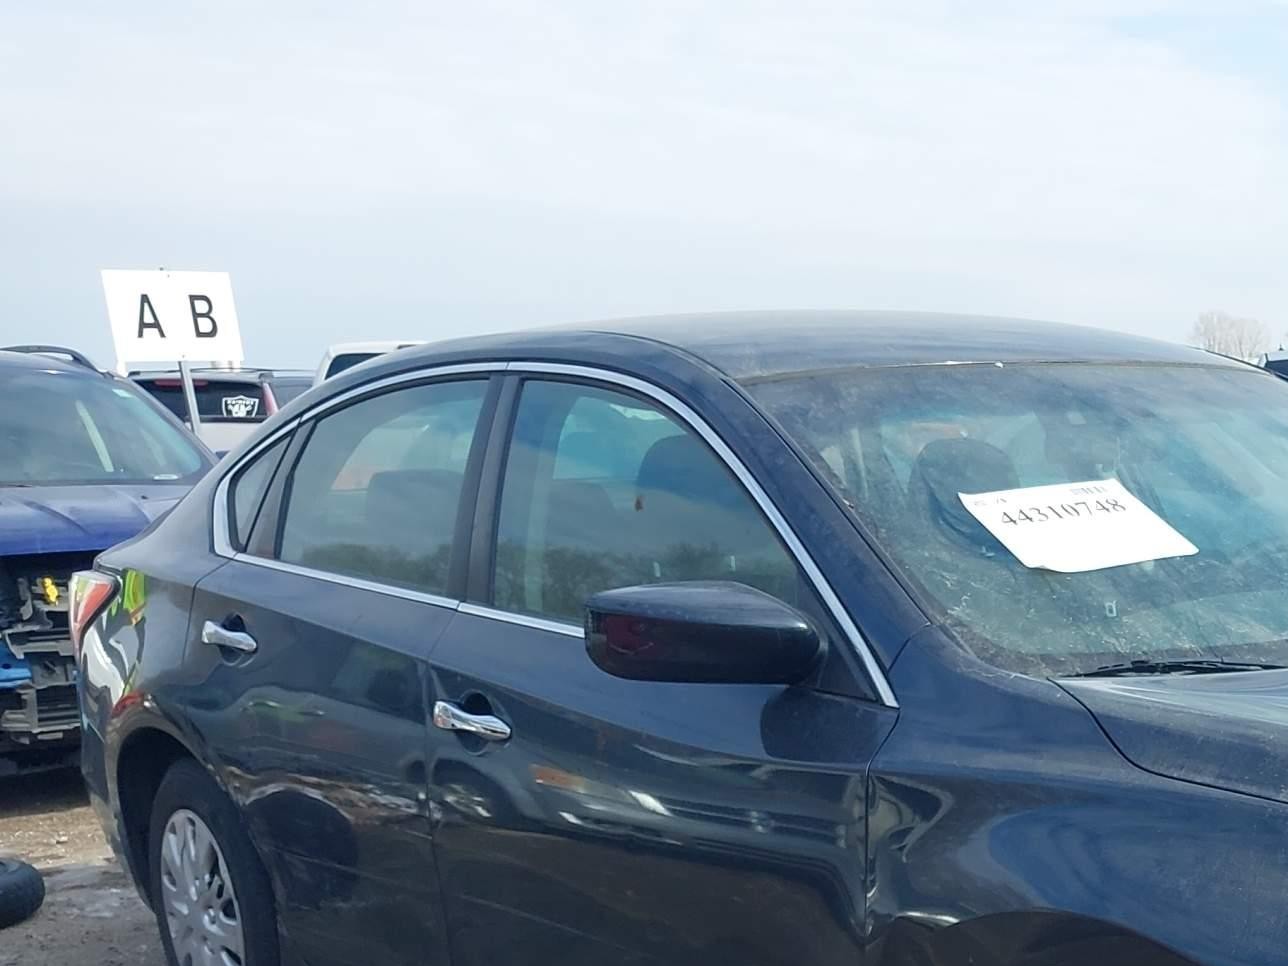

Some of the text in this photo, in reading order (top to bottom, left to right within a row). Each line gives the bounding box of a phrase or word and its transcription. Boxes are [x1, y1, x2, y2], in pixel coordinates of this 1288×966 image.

[138, 294, 218, 338] A B
[1000, 498, 1127, 526] 44310748
